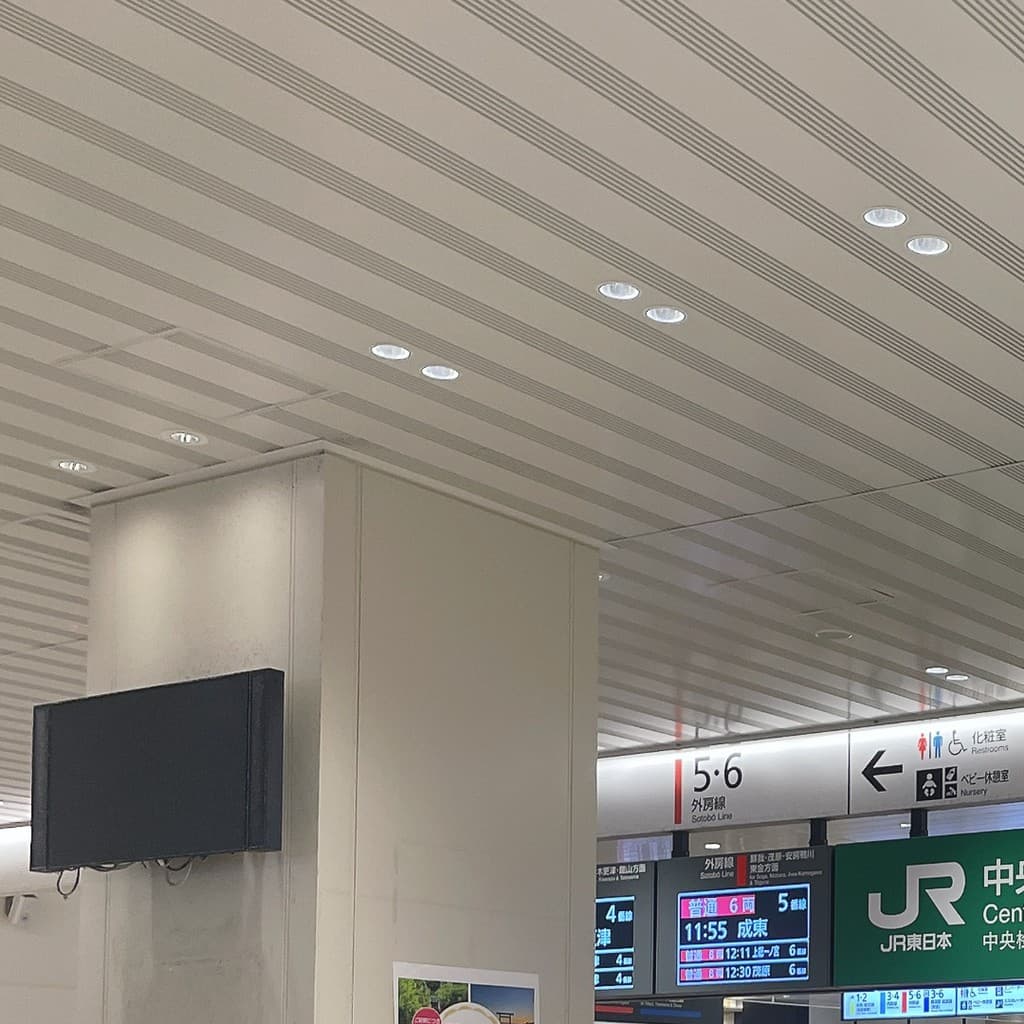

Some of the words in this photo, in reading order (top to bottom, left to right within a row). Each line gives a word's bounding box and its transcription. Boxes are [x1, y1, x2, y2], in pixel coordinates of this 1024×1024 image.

[972, 728, 1007, 745] 化粧室
[971, 744, 1009, 755] Restrooms
[960, 769, 1010, 785] ベビー休憩室
[960, 787, 988, 798] Nursery
[691, 796, 726, 812] 外房線
[717, 811, 733, 822] Line
[704, 857, 734, 870] 外房線
[868, 861, 966, 930] JR
[688, 900, 718, 918] 普通
[685, 920, 728, 941] 11:55
[737, 918, 768, 939] 成東
[880, 933, 952, 953] JR東日本
[725, 947, 750, 960] 12:11
[725, 966, 751, 979] 12:30
